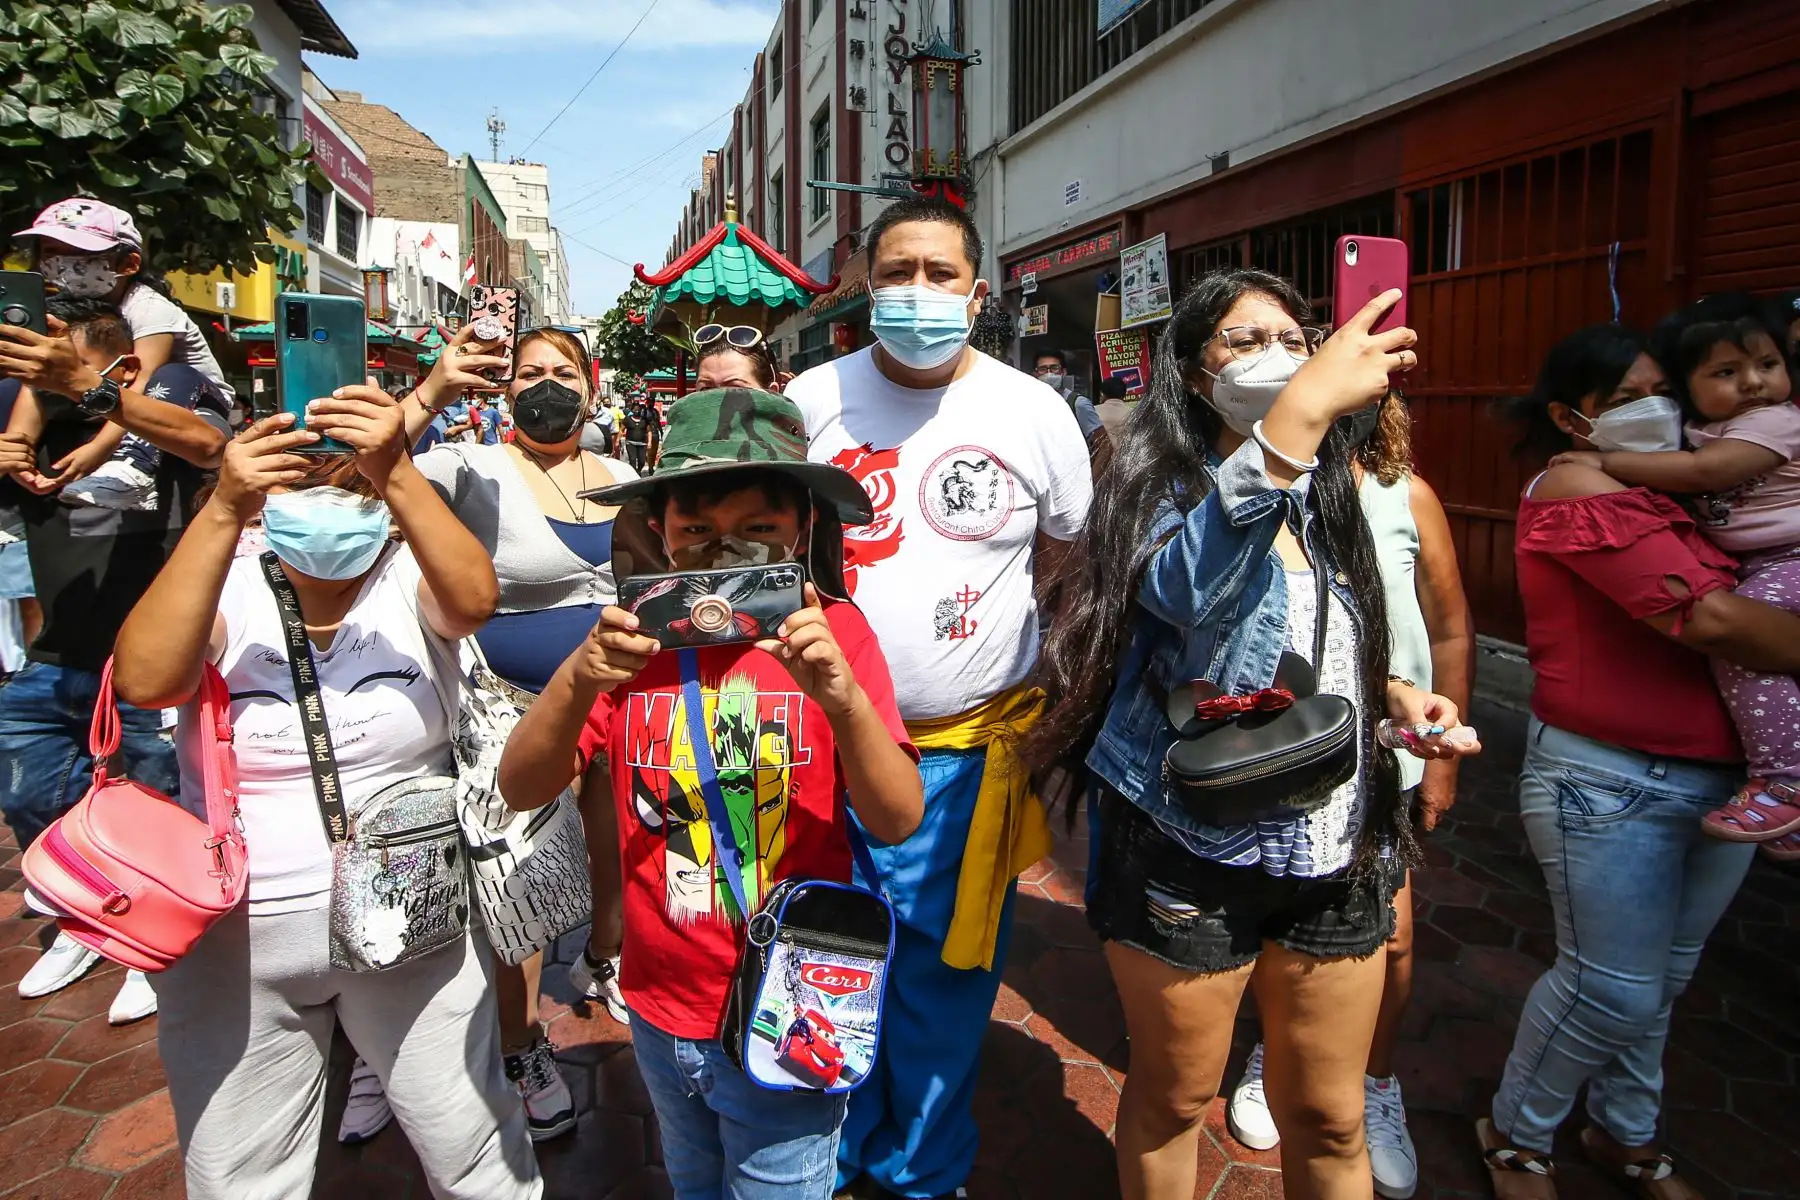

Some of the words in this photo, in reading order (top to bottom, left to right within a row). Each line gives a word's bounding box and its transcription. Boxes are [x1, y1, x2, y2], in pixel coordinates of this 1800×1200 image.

[885, 92, 910, 166] LAO
[1100, 335, 1146, 348] ACRILICAS
[1107, 346, 1118, 354] AL
[1122, 343, 1140, 352] POR
[1105, 352, 1135, 362] MAYOR
[1110, 358, 1141, 368] MENOR
[927, 496, 959, 530] Restaurant
[267, 562, 286, 582] PINK
[279, 589, 298, 611] PINK
[949, 584, 981, 641] 中山
[287, 620, 305, 647] PINK
[295, 656, 314, 684] PINK
[305, 694, 322, 722] PINK
[626, 692, 812, 770] MARVEL
[312, 733, 330, 762] PINK
[321, 772, 338, 803] PINK
[805, 967, 864, 989] Cars
